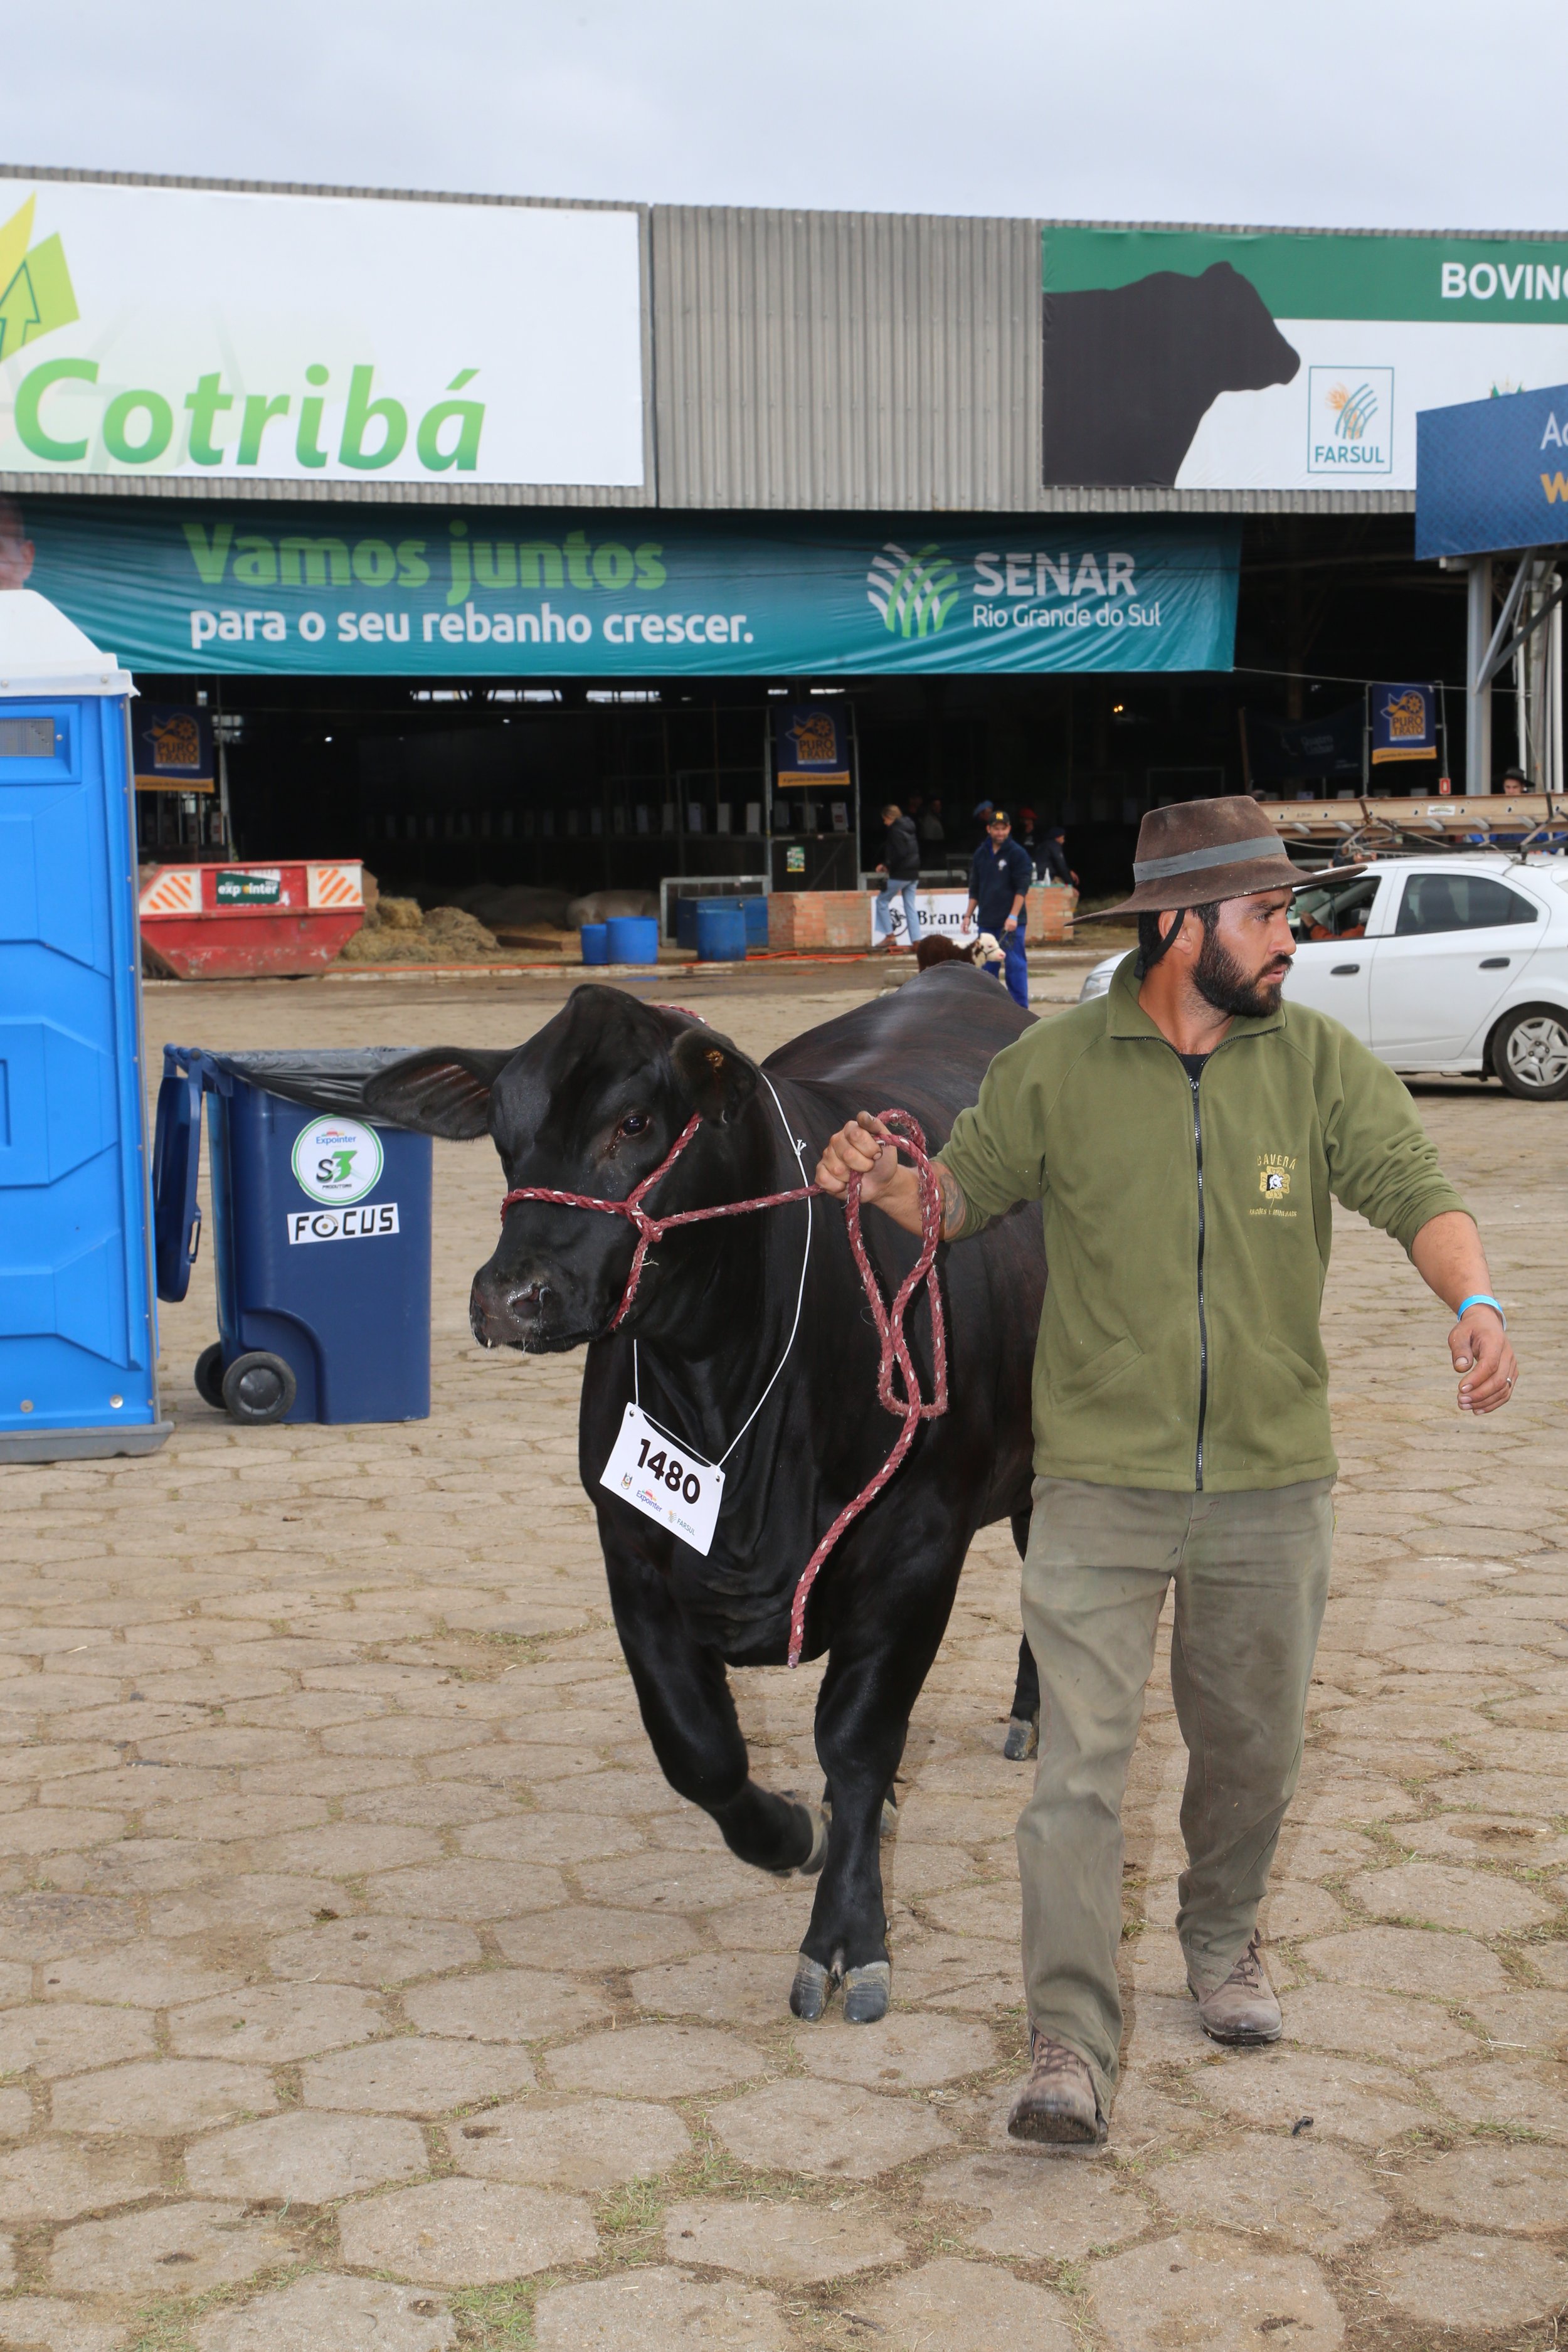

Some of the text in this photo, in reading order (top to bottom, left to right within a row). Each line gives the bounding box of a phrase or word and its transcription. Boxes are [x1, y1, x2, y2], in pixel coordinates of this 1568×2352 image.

[1441, 262, 1568, 300] BOVIN
[14, 358, 485, 472] Cotribá
[1315, 445, 1385, 464] FARSUL
[181, 519, 666, 607] Vamos juntos
[973, 553, 1138, 597] SENAR
[973, 600, 1161, 629] Rio Grande do Sul
[189, 601, 755, 650] para o seu rebanho crescer.
[1393, 716, 1423, 728] PURO
[1393, 726, 1424, 736] TRATO
[157, 741, 197, 754] PURO
[799, 739, 834, 751] PURO
[800, 750, 835, 760] TRATO
[159, 753, 198, 764] TRATO
[316, 1136, 356, 1145] Expointer
[295, 1207, 394, 1241] FOCUS
[637, 1438, 701, 1505] 1480
[637, 1490, 662, 1512] Expointer
[677, 1518, 695, 1536] FARSUL
